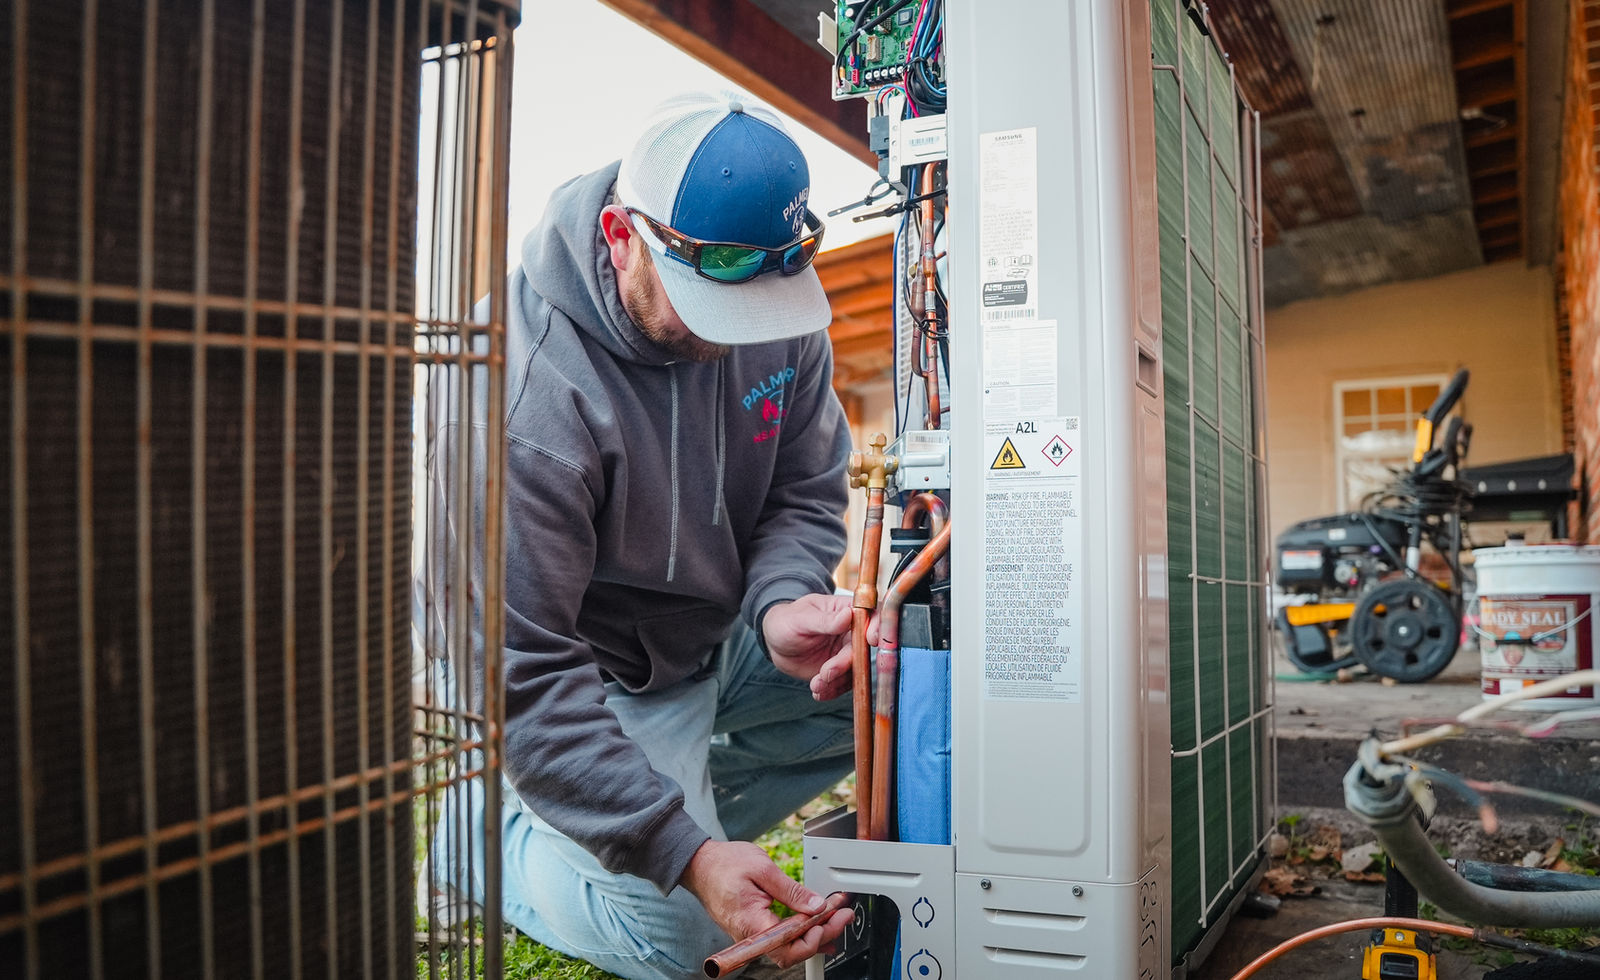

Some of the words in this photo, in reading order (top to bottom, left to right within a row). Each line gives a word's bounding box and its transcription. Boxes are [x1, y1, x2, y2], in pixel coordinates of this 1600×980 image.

[782, 187, 809, 222] PALME
[742, 367, 795, 410] PALMR
[1015, 421, 1038, 434] A2L
[1042, 491, 1072, 500] FLAMMABLE
[986, 501, 1018, 510] REFRIGERANT
[1040, 501, 1046, 509] BE
[1047, 500, 1071, 509] REPAIRED
[1006, 510, 1026, 518] TRAINED
[1028, 510, 1047, 518] SERVICE
[986, 538, 1010, 546] PROPERLY
[986, 546, 1006, 554] FEDERAL
[1522, 611, 1564, 625] SEAL
